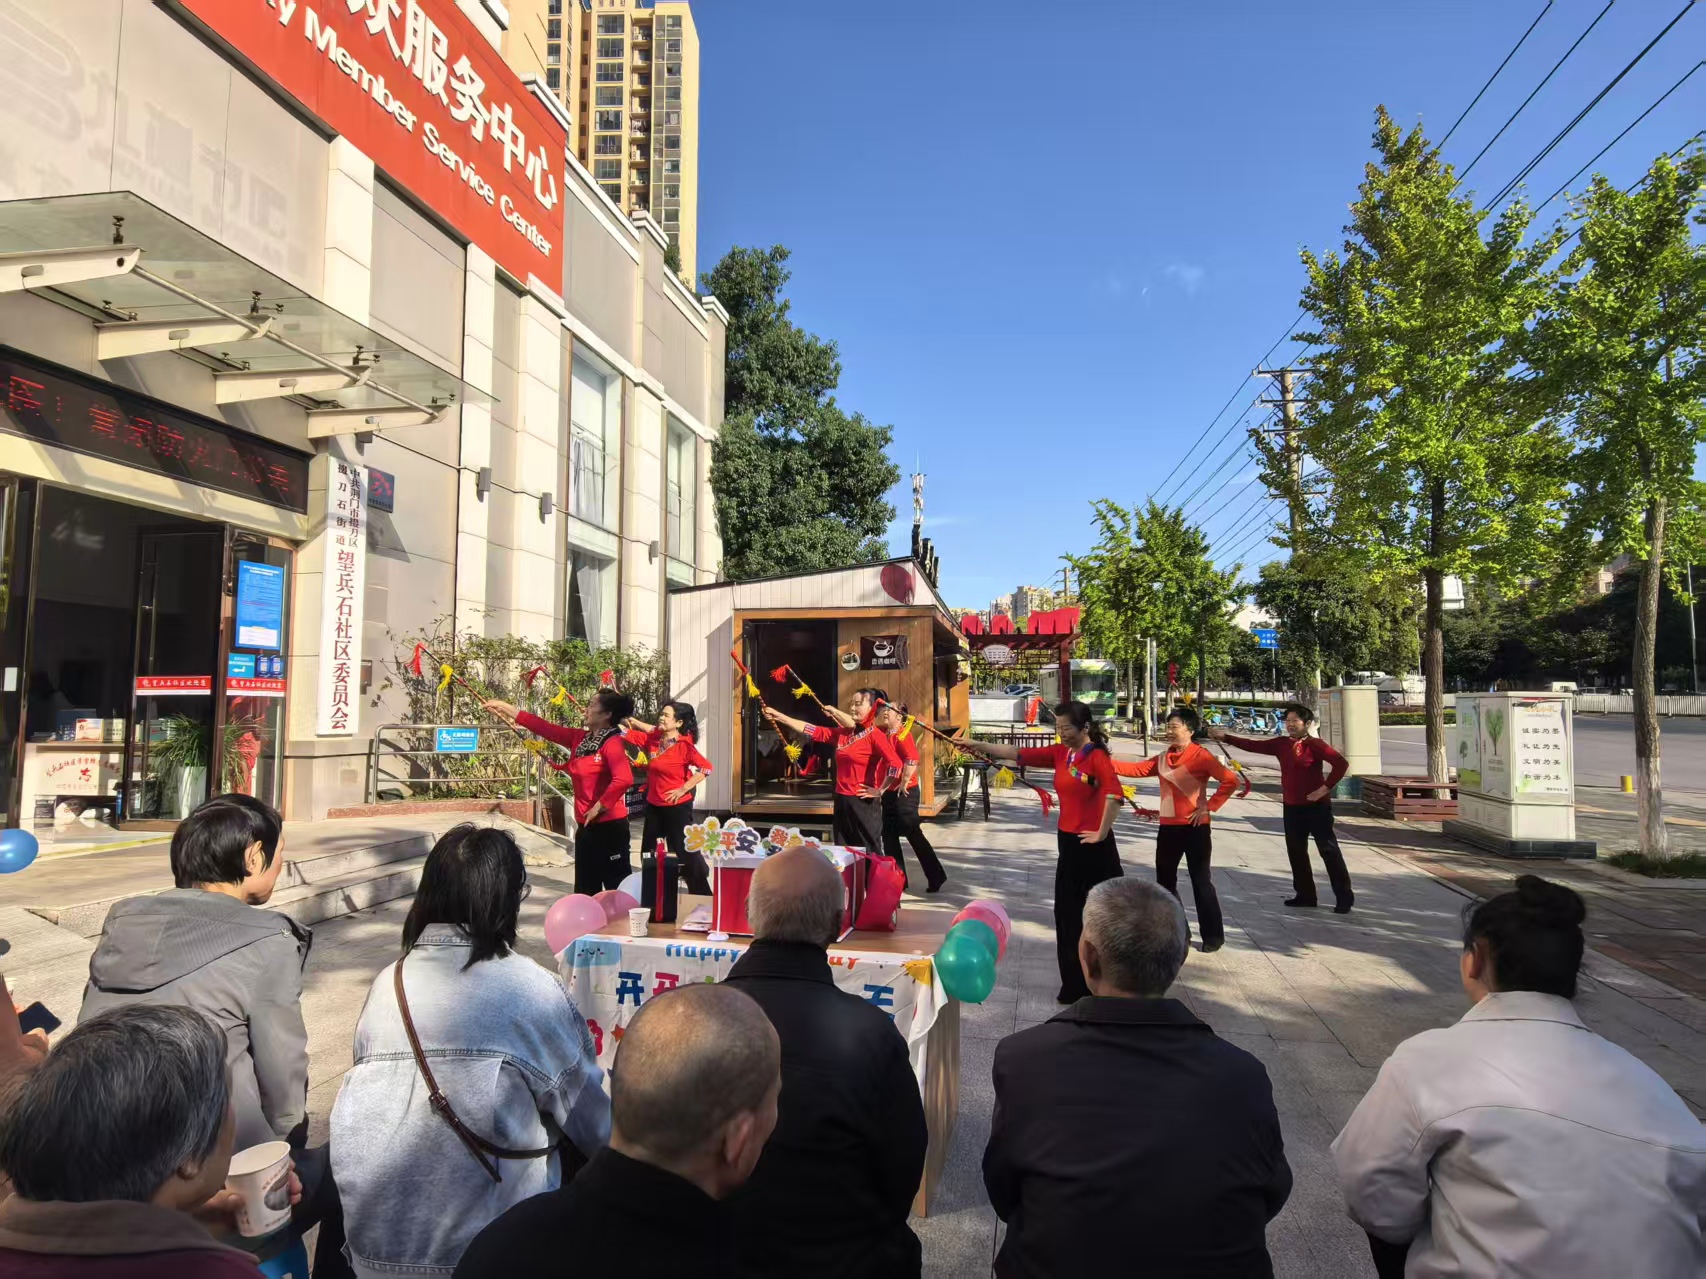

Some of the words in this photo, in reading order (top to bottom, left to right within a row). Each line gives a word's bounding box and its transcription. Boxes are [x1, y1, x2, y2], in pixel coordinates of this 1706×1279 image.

[304, 5, 416, 132] Member
[422, 121, 495, 205] Service
[500, 194, 552, 258] Center
[331, 549, 355, 730] 望兵石社区委员会
[686, 825, 759, 856] 岁岁平安
